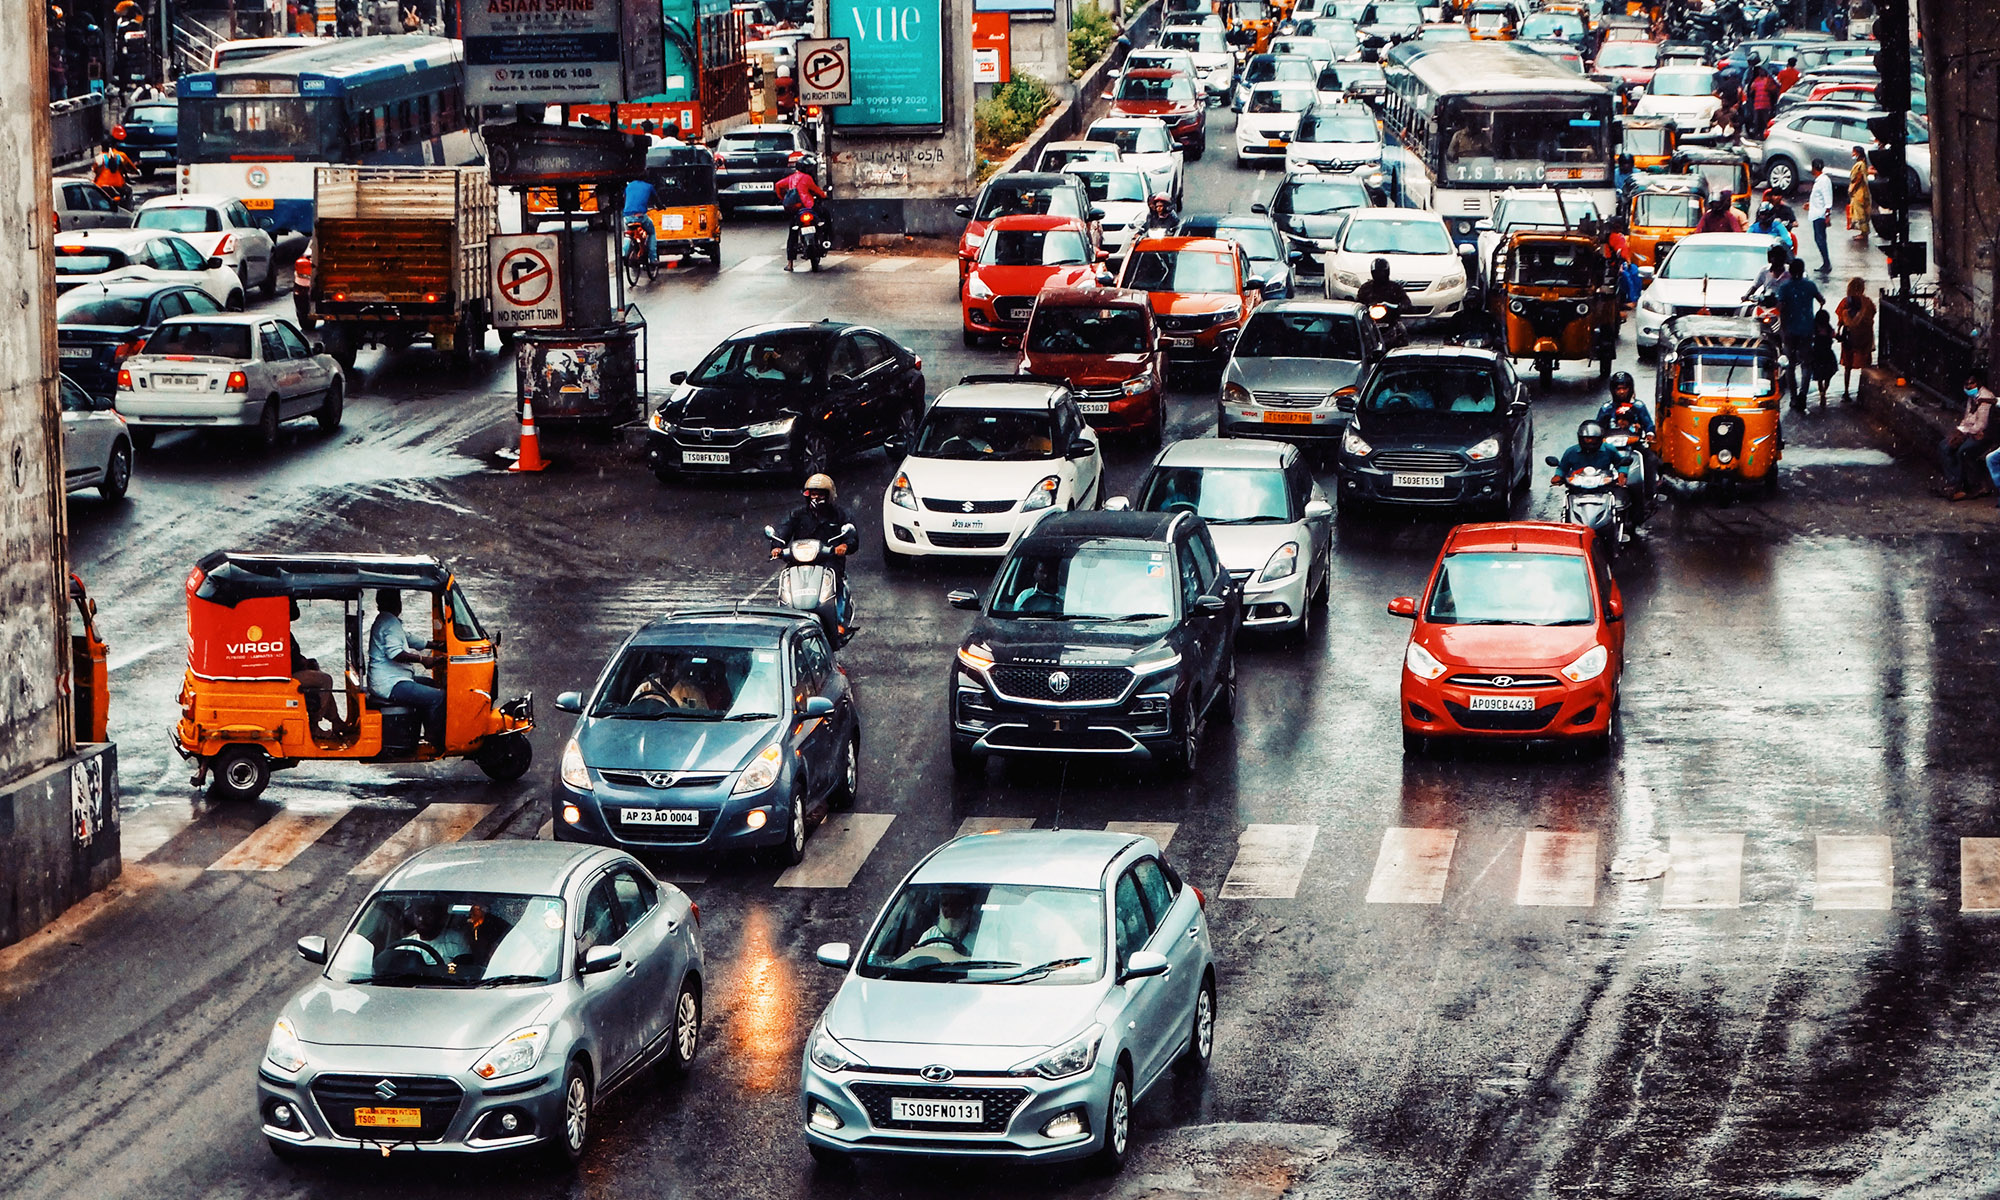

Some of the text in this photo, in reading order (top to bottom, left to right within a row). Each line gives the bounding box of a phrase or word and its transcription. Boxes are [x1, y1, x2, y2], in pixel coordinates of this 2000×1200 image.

[488, 0, 594, 12] ASIAN SPINE
[510, 70, 524, 79] 72
[529, 69, 549, 79] 108
[570, 68, 592, 78] 108
[802, 91, 846, 101] NO RIGHT TURN
[891, 96, 903, 104] 59
[498, 309, 558, 322] NO RIGHT TURN
[1398, 476, 1443, 485] TS03ET5151
[226, 641, 283, 654] VIRGO
[1050, 673, 1068, 691] MG
[1472, 698, 1534, 710] AP09CB4433
[626, 811, 692, 822] AP 23 AD 0004
[901, 1103, 979, 1118] TS09FN0131
